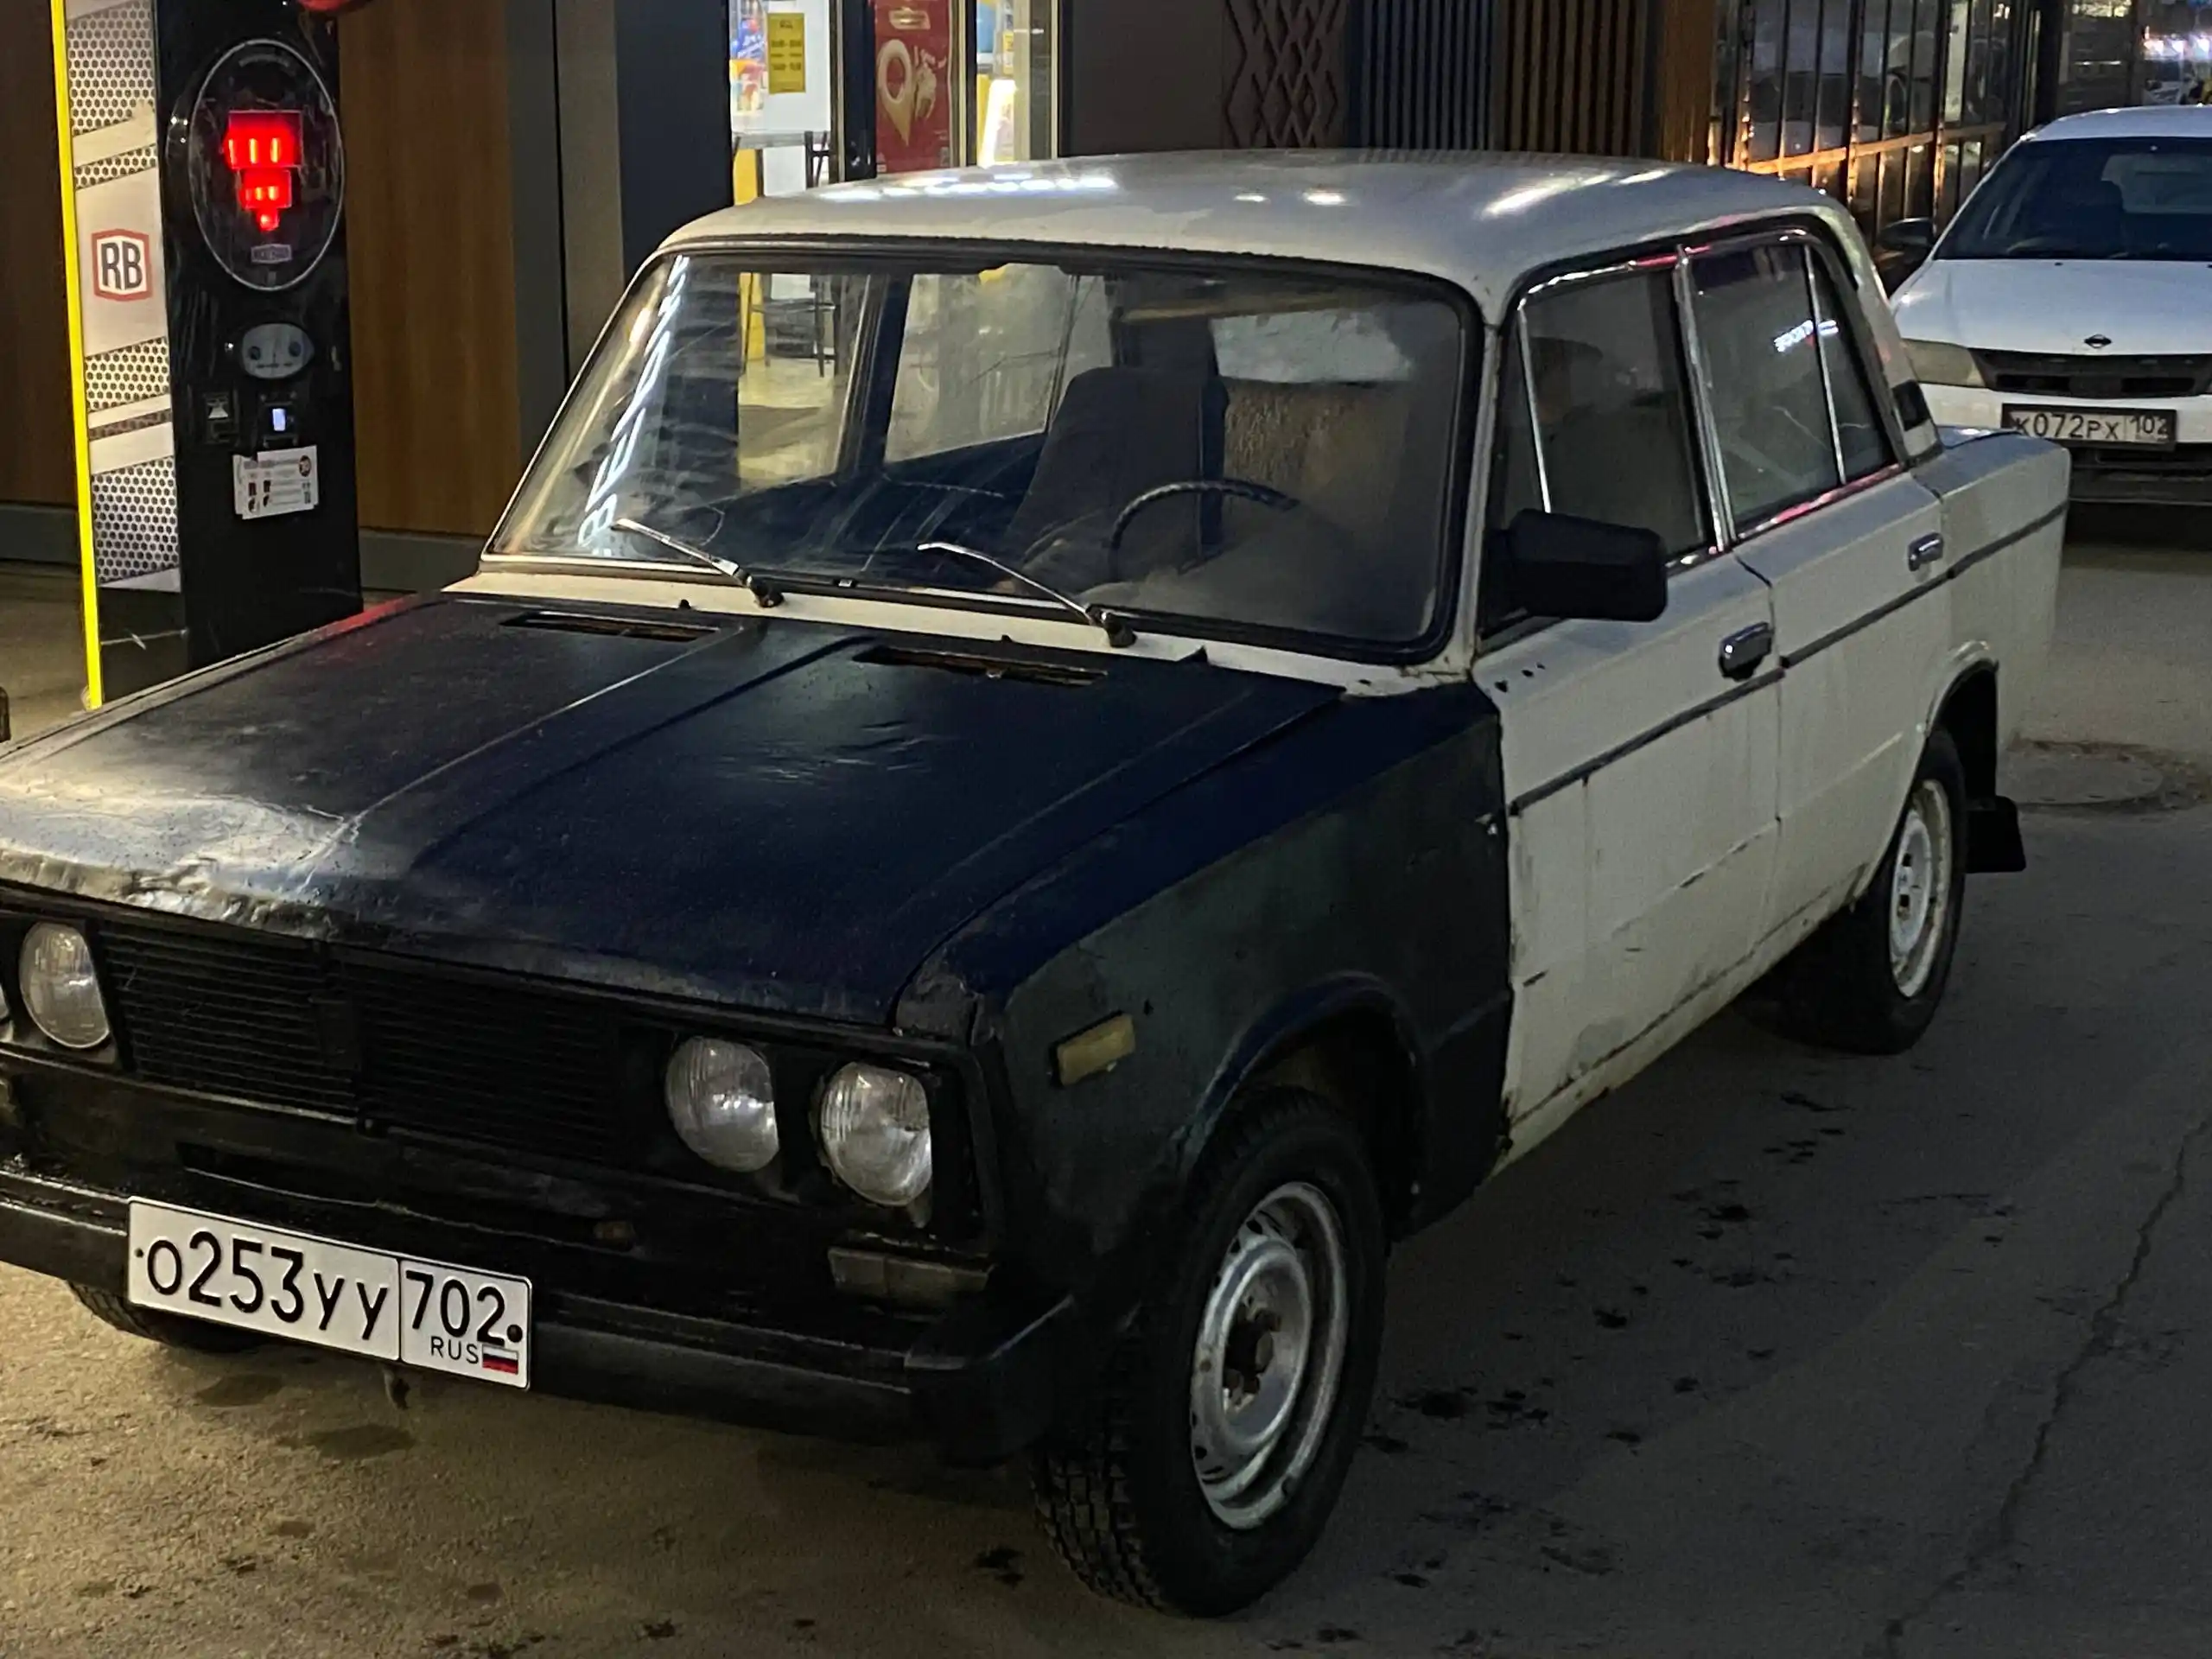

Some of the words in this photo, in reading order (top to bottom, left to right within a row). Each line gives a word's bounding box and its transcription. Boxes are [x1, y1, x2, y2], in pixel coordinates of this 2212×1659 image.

[101, 240, 143, 290] RB
[2129, 415, 2170, 436] 102
[146, 1230, 388, 1340] О253УУ
[405, 1270, 506, 1348] 702
[430, 1336, 480, 1365] RUS
